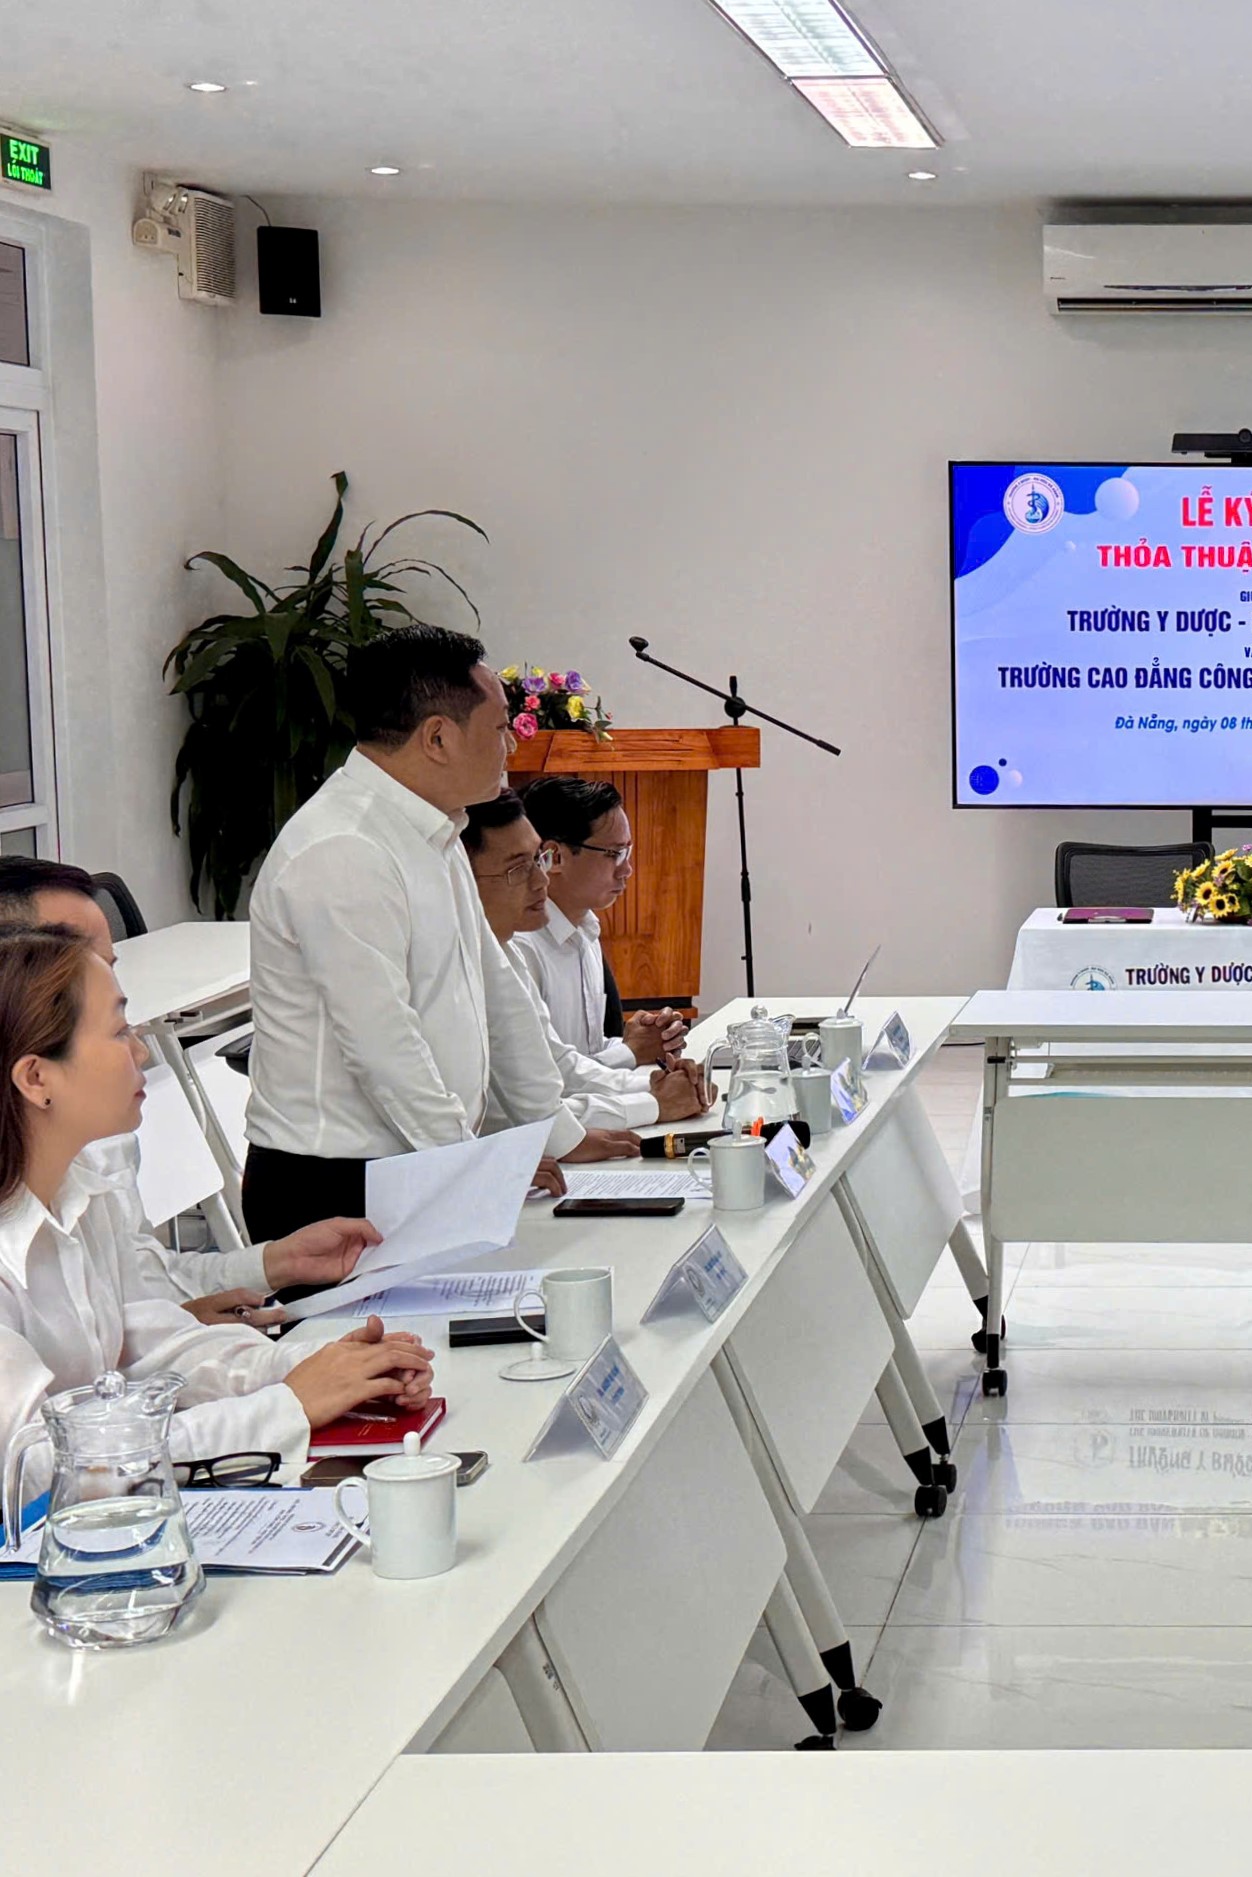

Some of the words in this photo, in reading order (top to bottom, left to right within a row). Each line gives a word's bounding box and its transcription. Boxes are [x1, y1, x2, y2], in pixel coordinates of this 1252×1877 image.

[9, 139, 40, 165] EXIT
[1182, 486, 1213, 527] LỄ
[1096, 538, 1172, 568] THỎA
[1067, 605, 1150, 632] TRƯỜNG
[1156, 610, 1169, 632] Y
[1176, 608, 1231, 637] DƯỢC
[998, 661, 1080, 688] TRƯỜNG
[1087, 667, 1127, 688] CAO
[1134, 657, 1192, 689] ĐẲNG
[1115, 715, 1135, 729] Đà
[1182, 715, 1217, 733] ngày
[1220, 716, 1237, 730] 08
[1125, 962, 1191, 985] TRƯỜNG
[1195, 966, 1205, 983] Y
